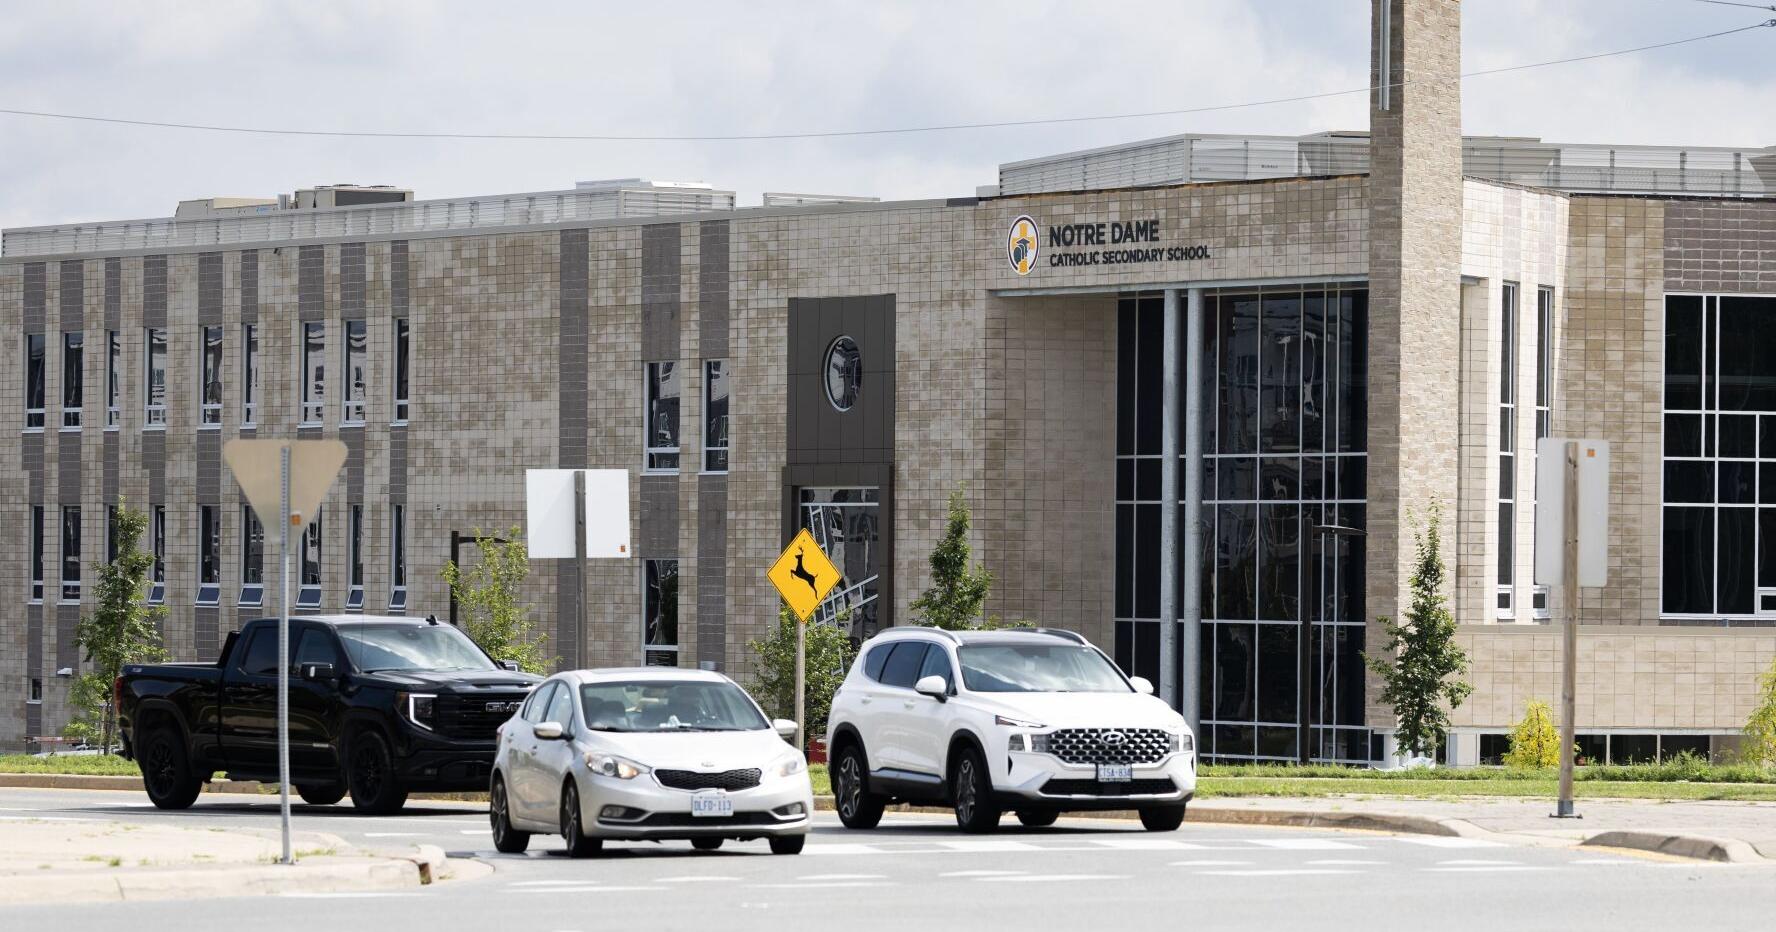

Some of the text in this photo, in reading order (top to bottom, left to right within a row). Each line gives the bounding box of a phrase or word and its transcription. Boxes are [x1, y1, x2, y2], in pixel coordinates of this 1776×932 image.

[1049, 219, 1160, 247] NOTRE DAME
[1049, 245, 1211, 267] CATHOLIC SECONDARY SCHOOL
